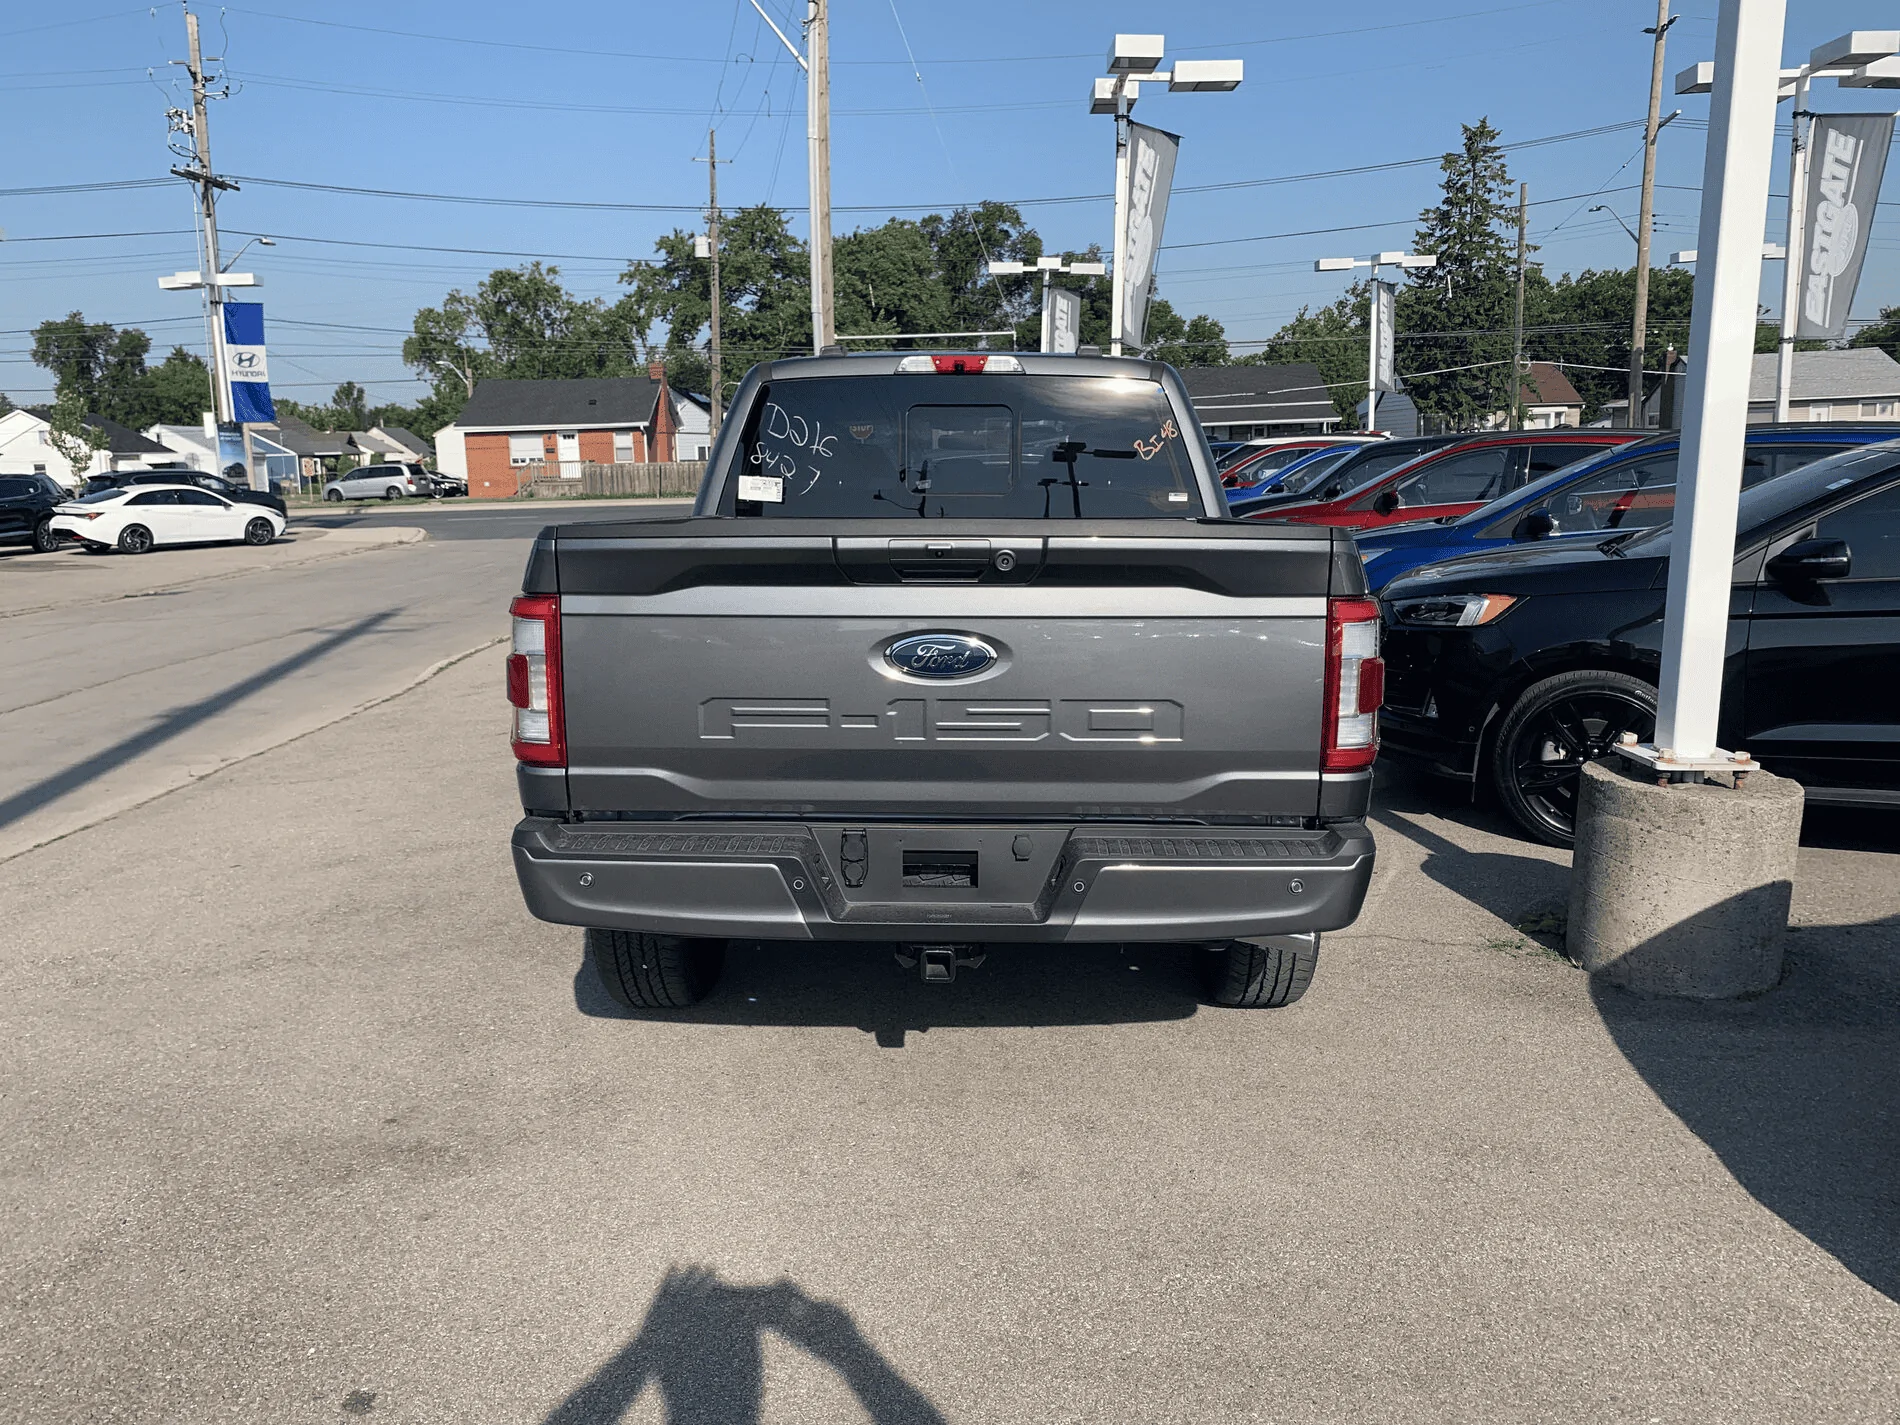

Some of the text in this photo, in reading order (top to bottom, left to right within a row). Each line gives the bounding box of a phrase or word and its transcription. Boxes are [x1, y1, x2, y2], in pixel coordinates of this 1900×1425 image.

[1805, 127, 1857, 326] EASTGATE
[911, 644, 970, 669] Ford
[700, 697, 1184, 742] F-150
